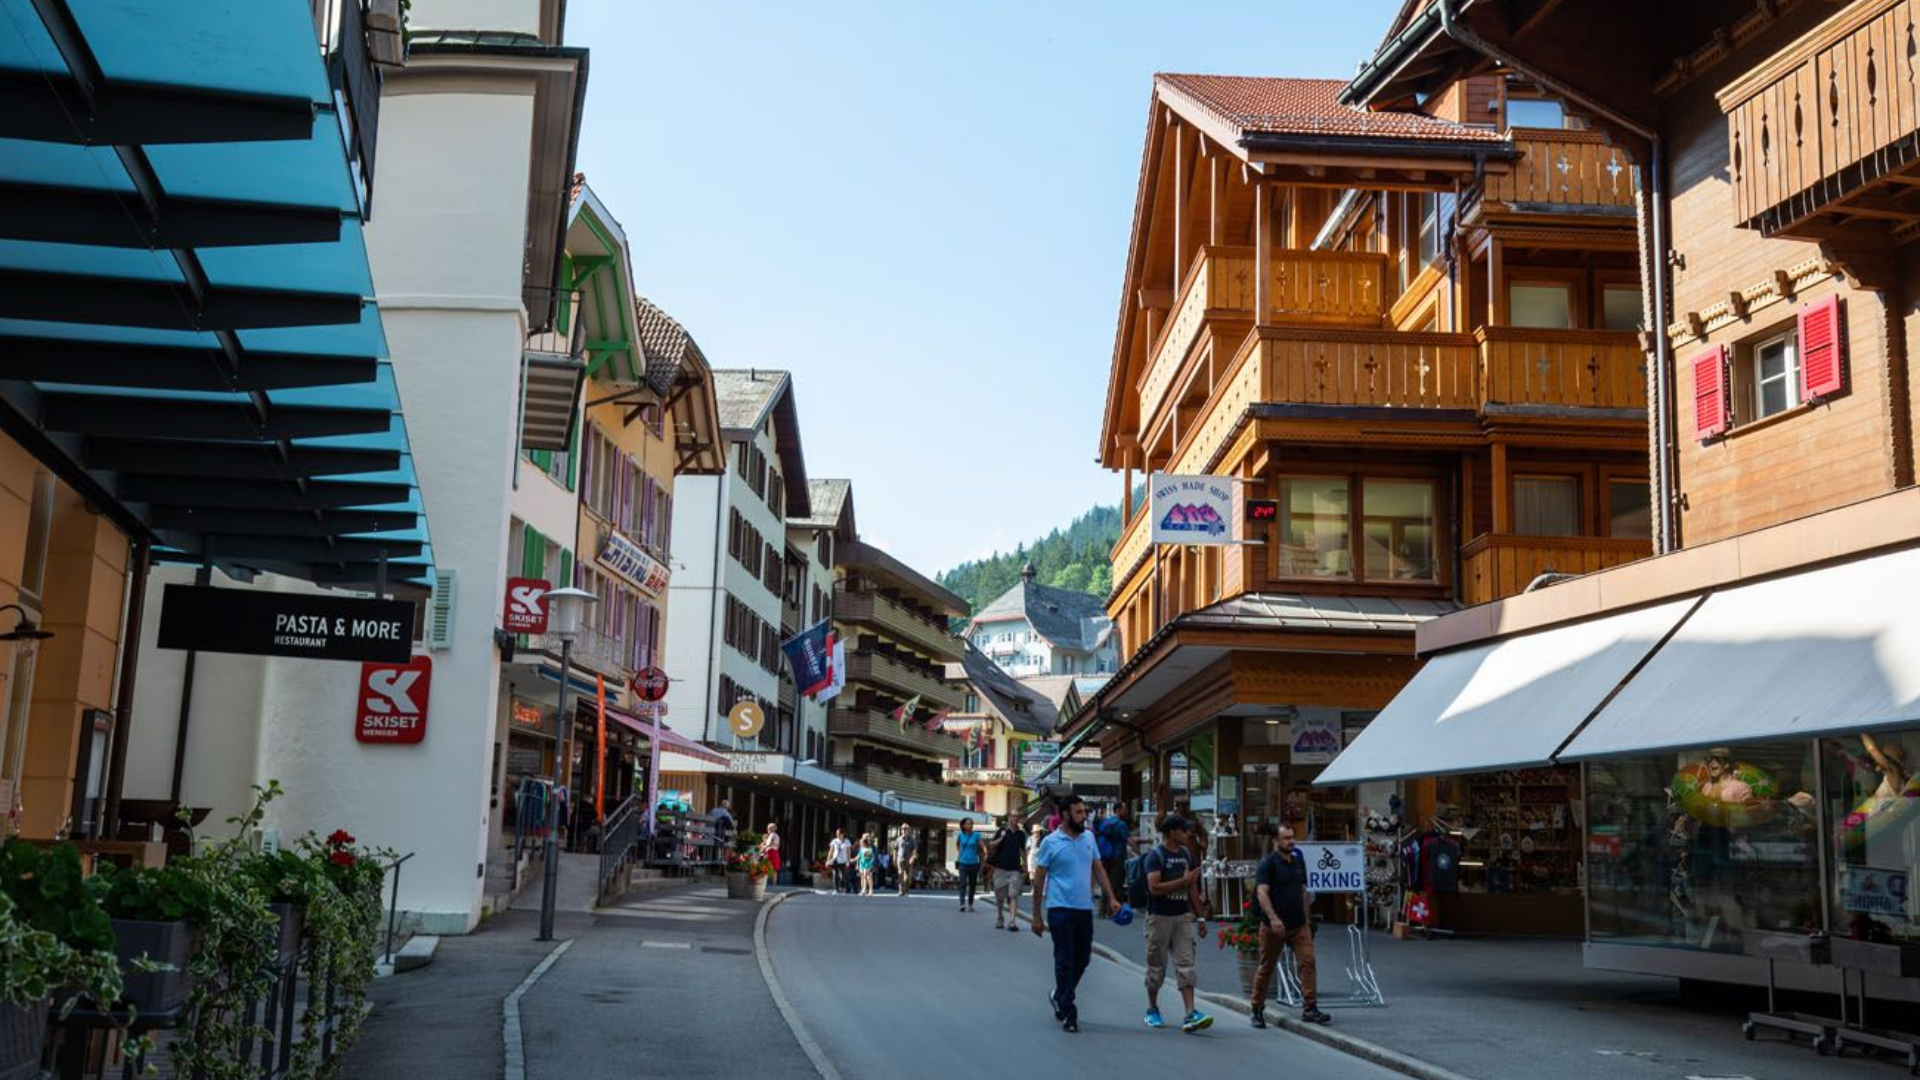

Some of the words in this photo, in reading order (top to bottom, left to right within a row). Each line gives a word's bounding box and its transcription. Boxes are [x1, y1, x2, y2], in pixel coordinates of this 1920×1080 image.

[1156, 484, 1178, 501] SWISS
[1182, 481, 1205, 492] MADE
[1209, 486, 1230, 502] SHOP
[275, 613, 328, 635] PASTA
[334, 618, 346, 636] &
[351, 619, 401, 639] MORE
[508, 614, 544, 624] SKISET
[274, 635, 327, 648] RESTAURANT
[363, 715, 419, 728] SKISET
[739, 708, 753, 731] S
[1308, 871, 1361, 888] RKING
